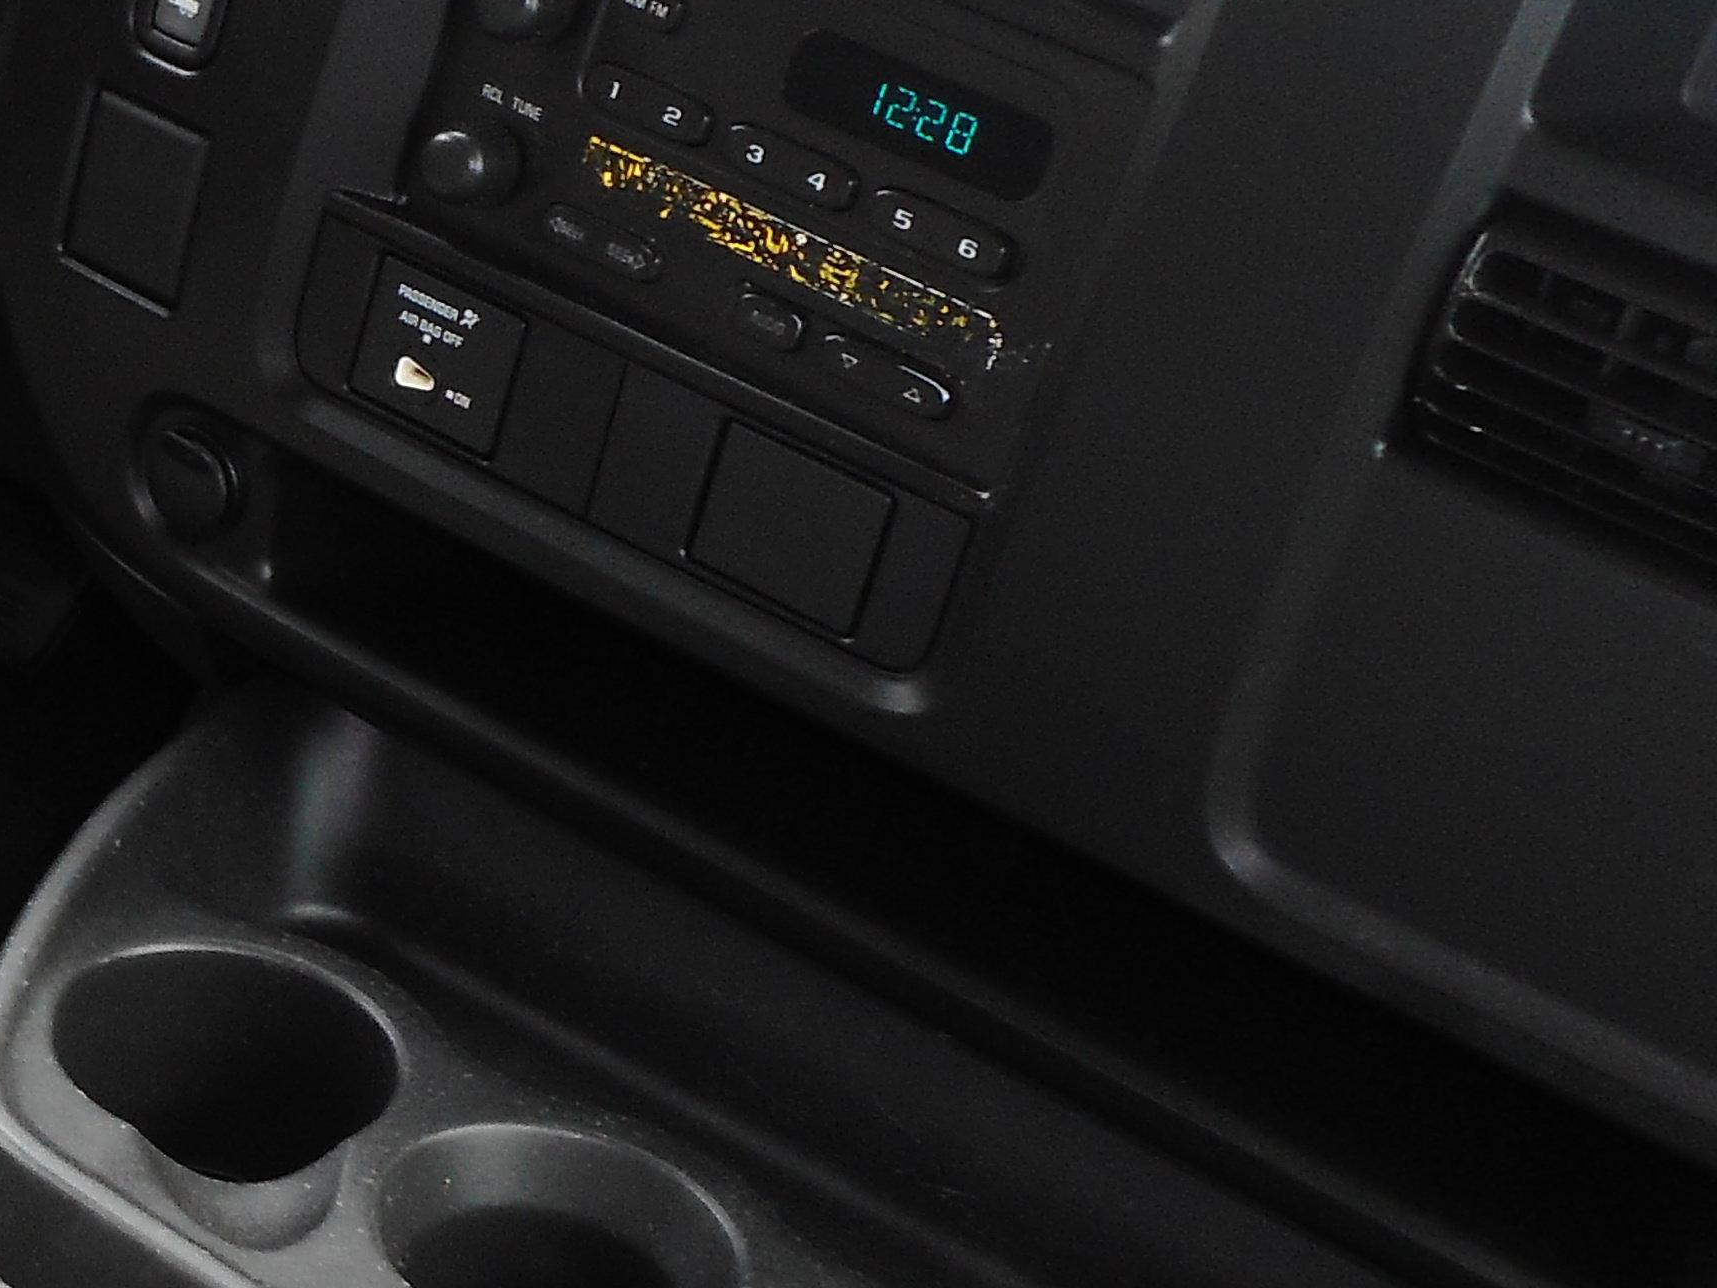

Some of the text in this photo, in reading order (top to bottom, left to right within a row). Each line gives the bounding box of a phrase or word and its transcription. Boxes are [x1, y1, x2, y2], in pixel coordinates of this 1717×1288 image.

[649, 0, 669, 19] FM
[609, 81, 621, 100] 1
[511, 96, 543, 123] TUNE
[662, 106, 682, 127] 2
[745, 143, 766, 165] 3
[806, 171, 828, 192] 4
[892, 208, 914, 231] 5
[957, 238, 980, 260] 6
[399, 310, 419, 327] AIR
[442, 330, 464, 348] OFF
